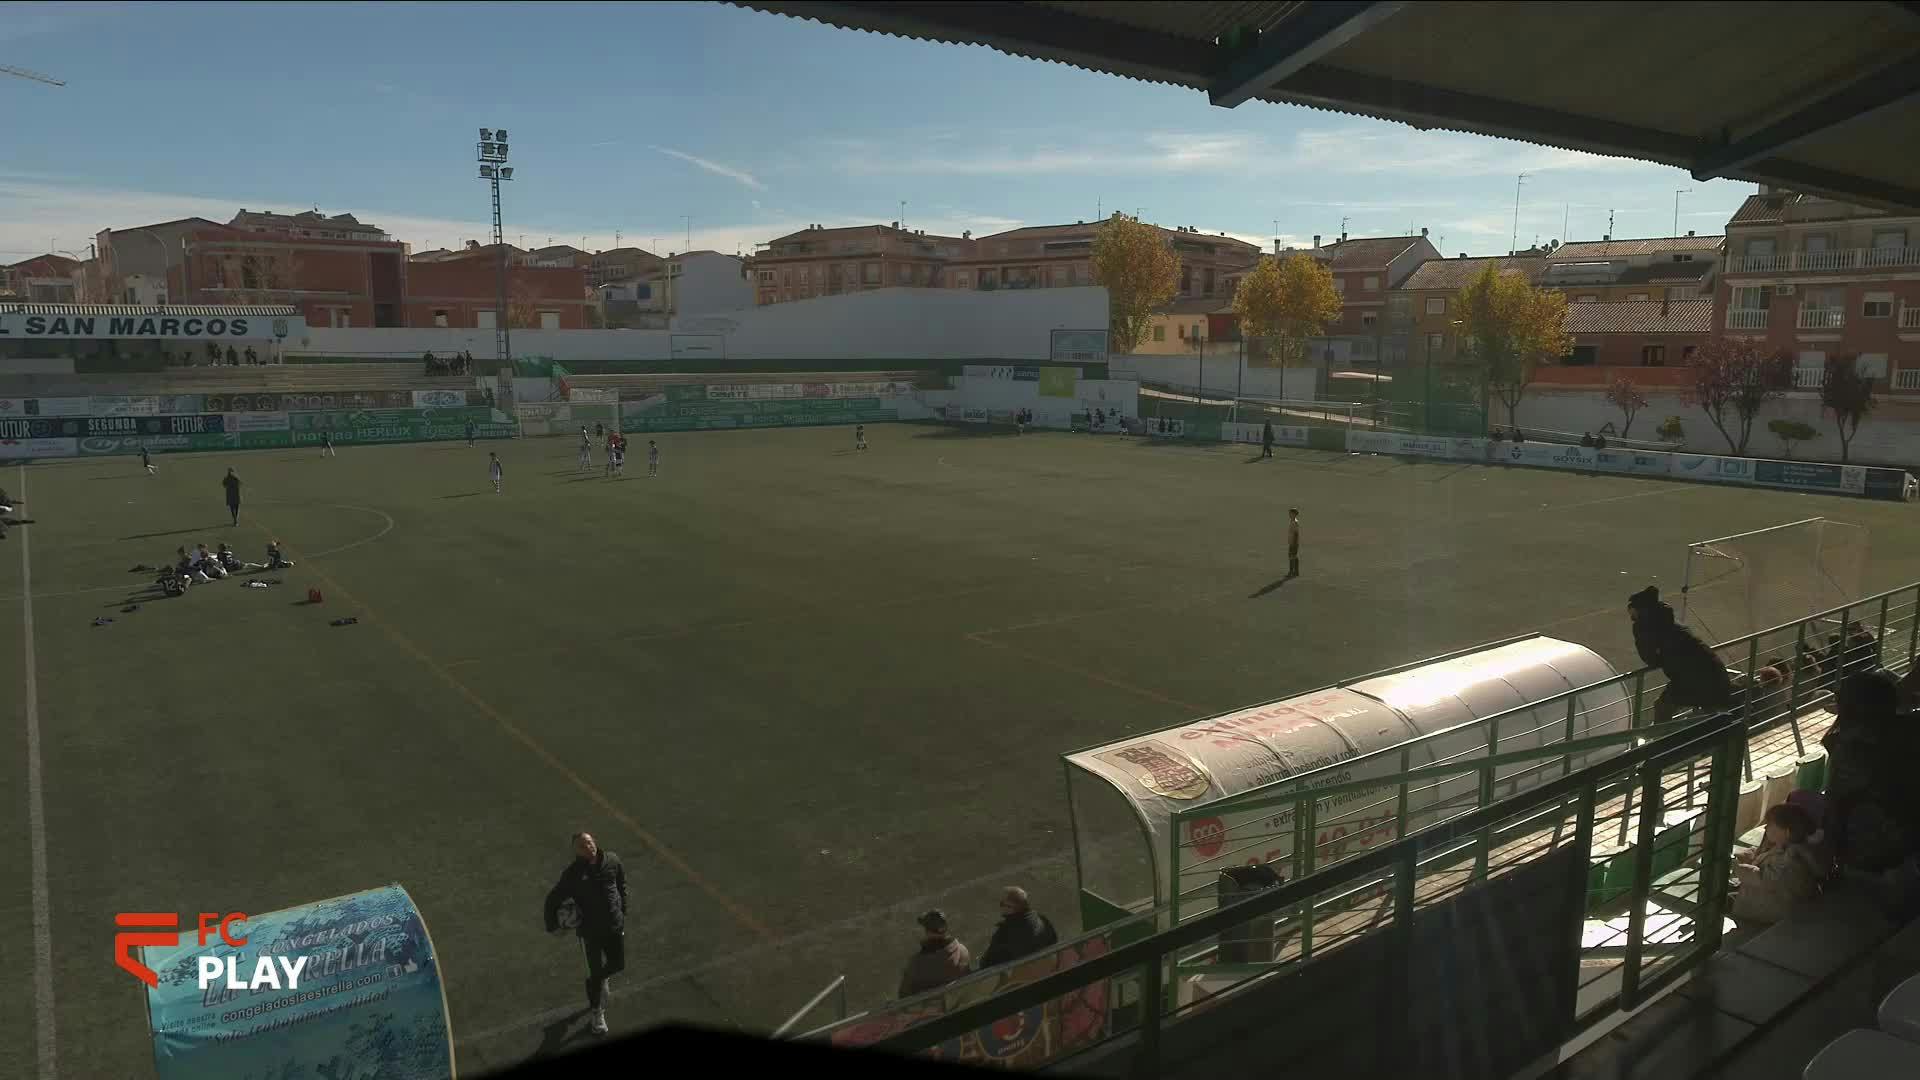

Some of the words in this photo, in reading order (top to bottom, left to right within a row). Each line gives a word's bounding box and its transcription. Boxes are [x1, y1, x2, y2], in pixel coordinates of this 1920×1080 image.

[25, 317, 95, 336] SAN
[109, 317, 249, 336] MARCOS
[0, 419, 32, 438] UTUR
[257, 914, 394, 957] CONGELADOS
